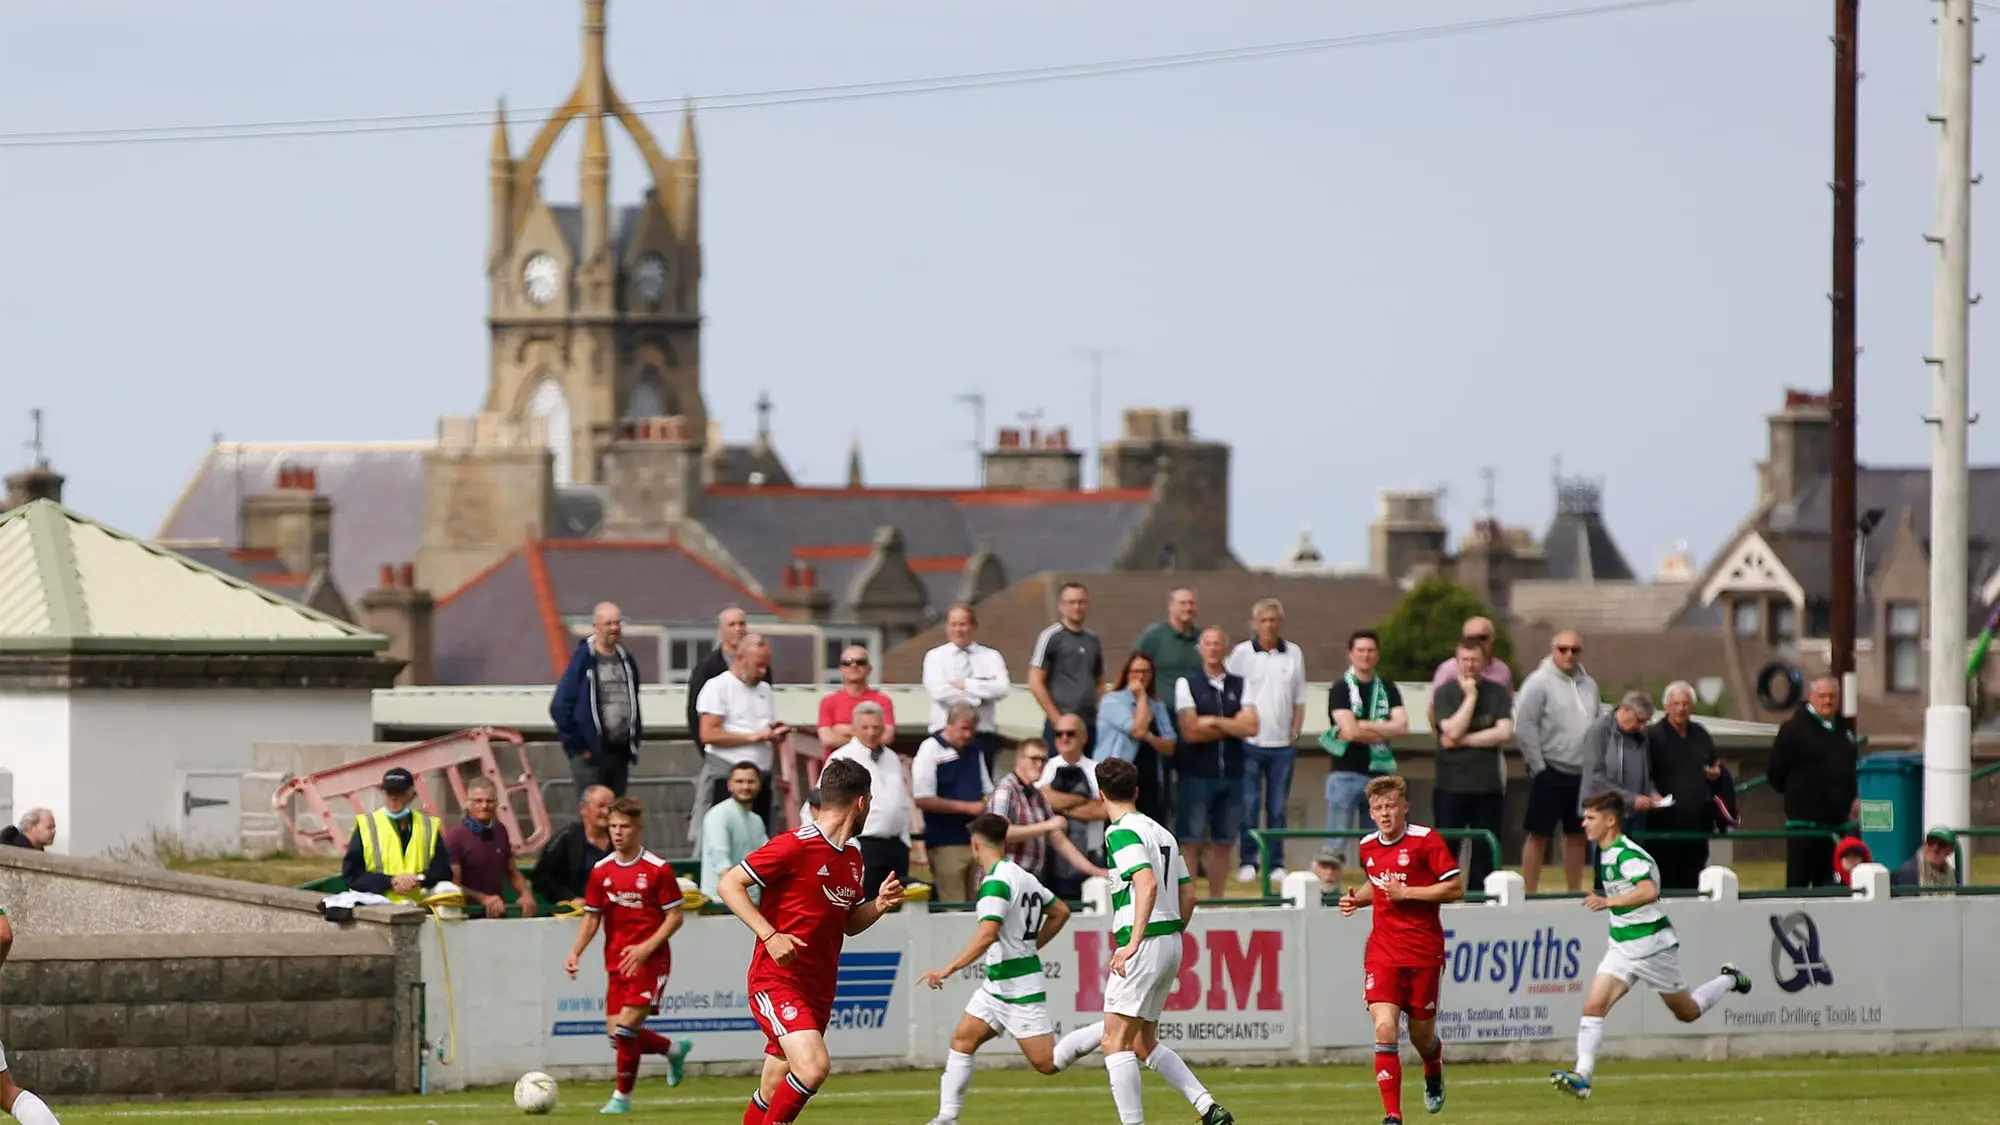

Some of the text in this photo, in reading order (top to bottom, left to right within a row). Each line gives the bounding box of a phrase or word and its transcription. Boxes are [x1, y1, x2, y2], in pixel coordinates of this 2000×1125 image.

[1158, 844, 1172, 891] 7
[1020, 891, 1045, 941] 22
[829, 1003, 886, 1030] ector
[1724, 1004, 1882, 1028] Premium Drilling Tools Ltd
[1188, 1021, 1270, 1041] MERCHANTS
